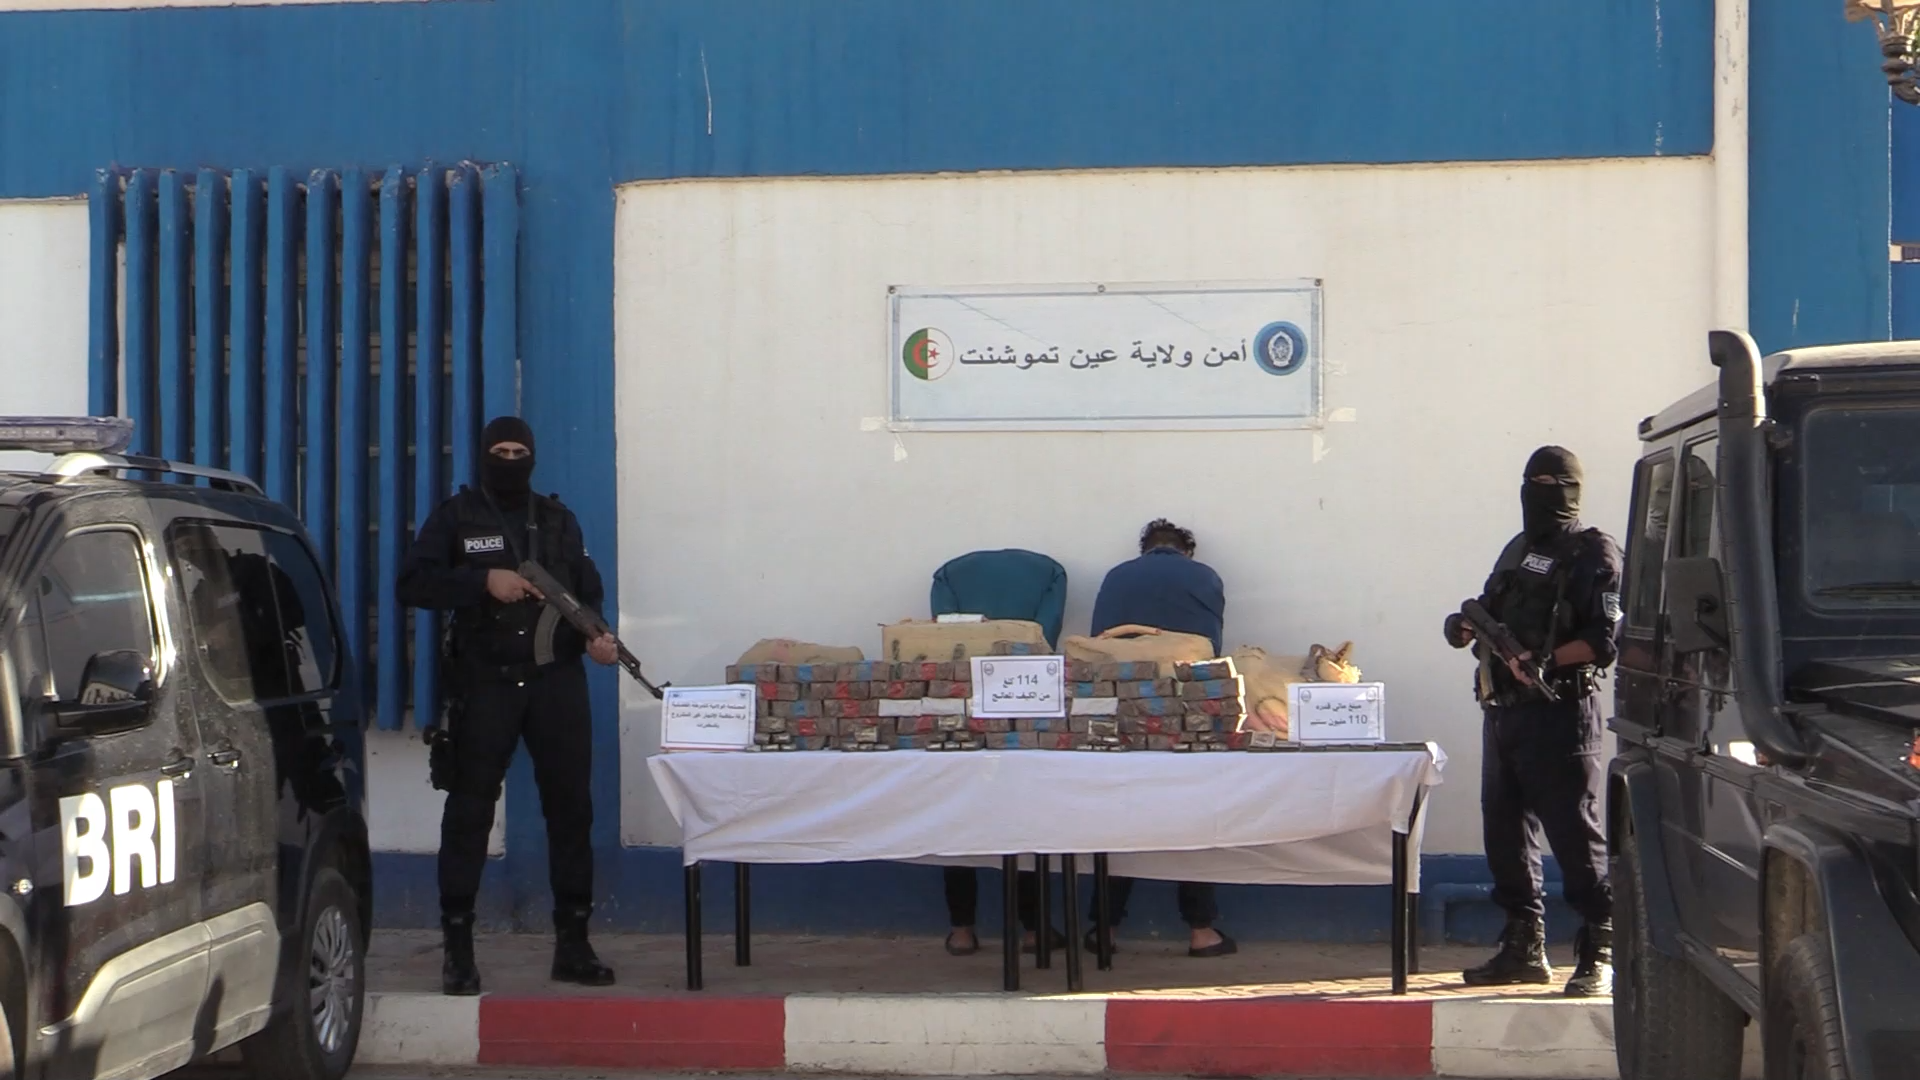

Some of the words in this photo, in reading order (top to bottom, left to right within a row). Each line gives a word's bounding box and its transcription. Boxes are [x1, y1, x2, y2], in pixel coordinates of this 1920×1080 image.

[959, 345, 1059, 370] تموشنت
[1069, 348, 1118, 369] عين
[1130, 340, 1193, 368] ولاية
[1203, 338, 1247, 368] أمن
[466, 538, 502, 550] POLICE
[1524, 556, 1551, 571] POLICE
[1017, 674, 1038, 685] 114
[1039, 692, 1050, 701] من
[1349, 714, 1368, 724] 110
[58, 779, 176, 907] BRI
